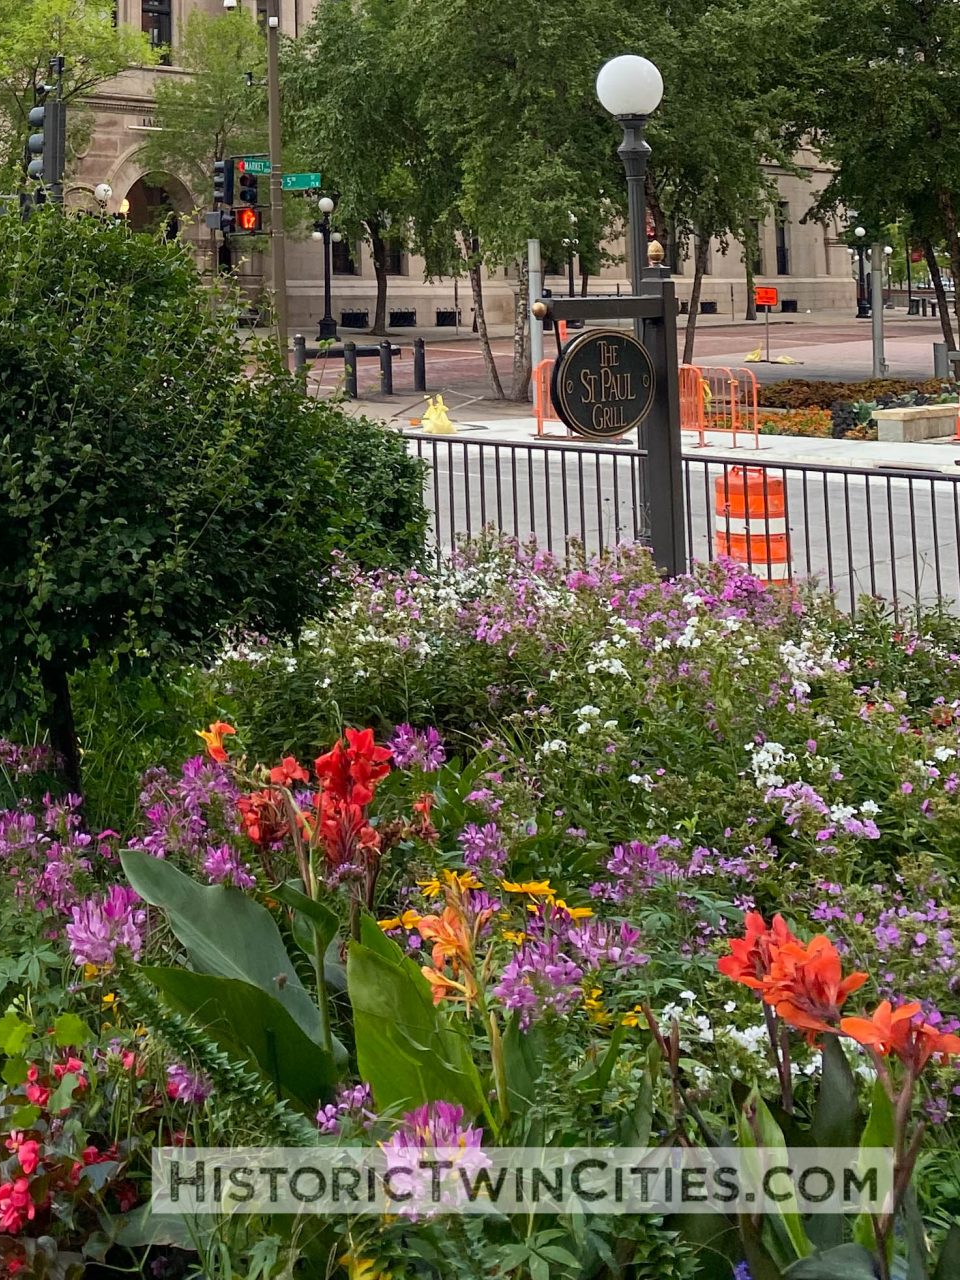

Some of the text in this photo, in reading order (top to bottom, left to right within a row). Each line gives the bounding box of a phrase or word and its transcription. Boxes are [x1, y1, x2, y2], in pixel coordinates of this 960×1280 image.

[244, 161, 264, 172] MARKET
[597, 341, 619, 367] THE
[580, 368, 636, 403] ST PAUL
[593, 404, 627, 430] GRILL
